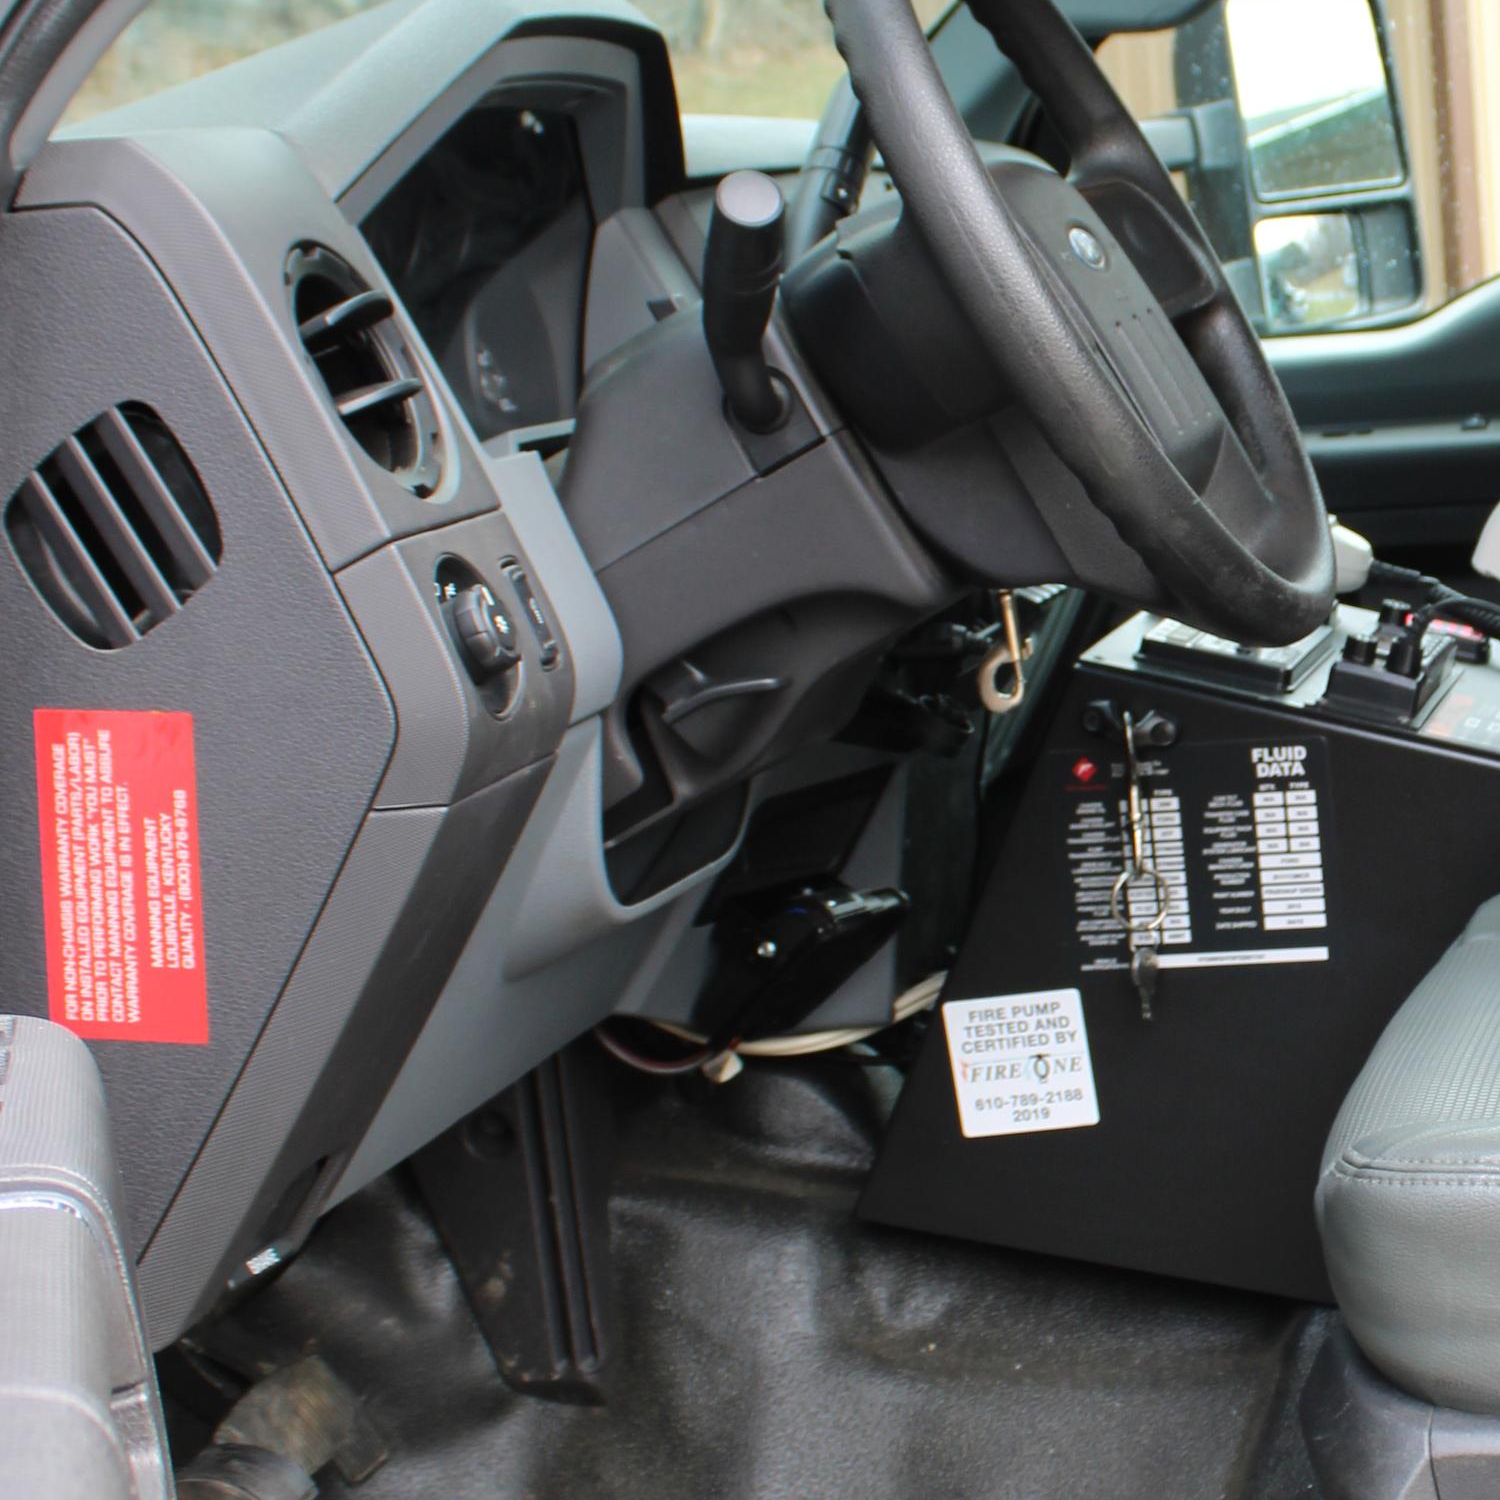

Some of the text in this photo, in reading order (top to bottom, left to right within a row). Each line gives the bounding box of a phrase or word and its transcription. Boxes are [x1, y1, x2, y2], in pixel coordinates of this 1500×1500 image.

[1251, 746, 1307, 763] FLUID
[1256, 762, 1305, 778] DATA
[87, 823, 100, 866] WORK
[159, 813, 175, 886] KENTUCKY
[53, 744, 78, 1020] FOR NON-CHASSIS WARRANTY COVERAGE
[68, 732, 93, 1020] ON INSTALLED EQUIPMENT (PARTS/LABOR)
[97, 730, 124, 1022] CONTACT MANNING EQUIPMENT TO ASSURE
[144, 818, 164, 967] MANNING EQUIPMENT
[90, 869, 106, 957] PERFORMING
[116, 783, 141, 1022] WARRANTY COVERAGE IS IN EFFECT.
[180, 912, 195, 969] QUALITY
[94, 960, 106, 977] TO
[96, 981, 108, 1022] PRIOR
[968, 1002, 1061, 1023] FIRE PUMP
[961, 1030, 1078, 1054] CERTIFIED BY
[964, 1016, 1070, 1038] TESTED AND
[970, 1063, 1021, 1083] FIRE
[975, 1088, 1084, 1111] 610-789-2188
[1013, 1107, 1050, 1123] 2019
